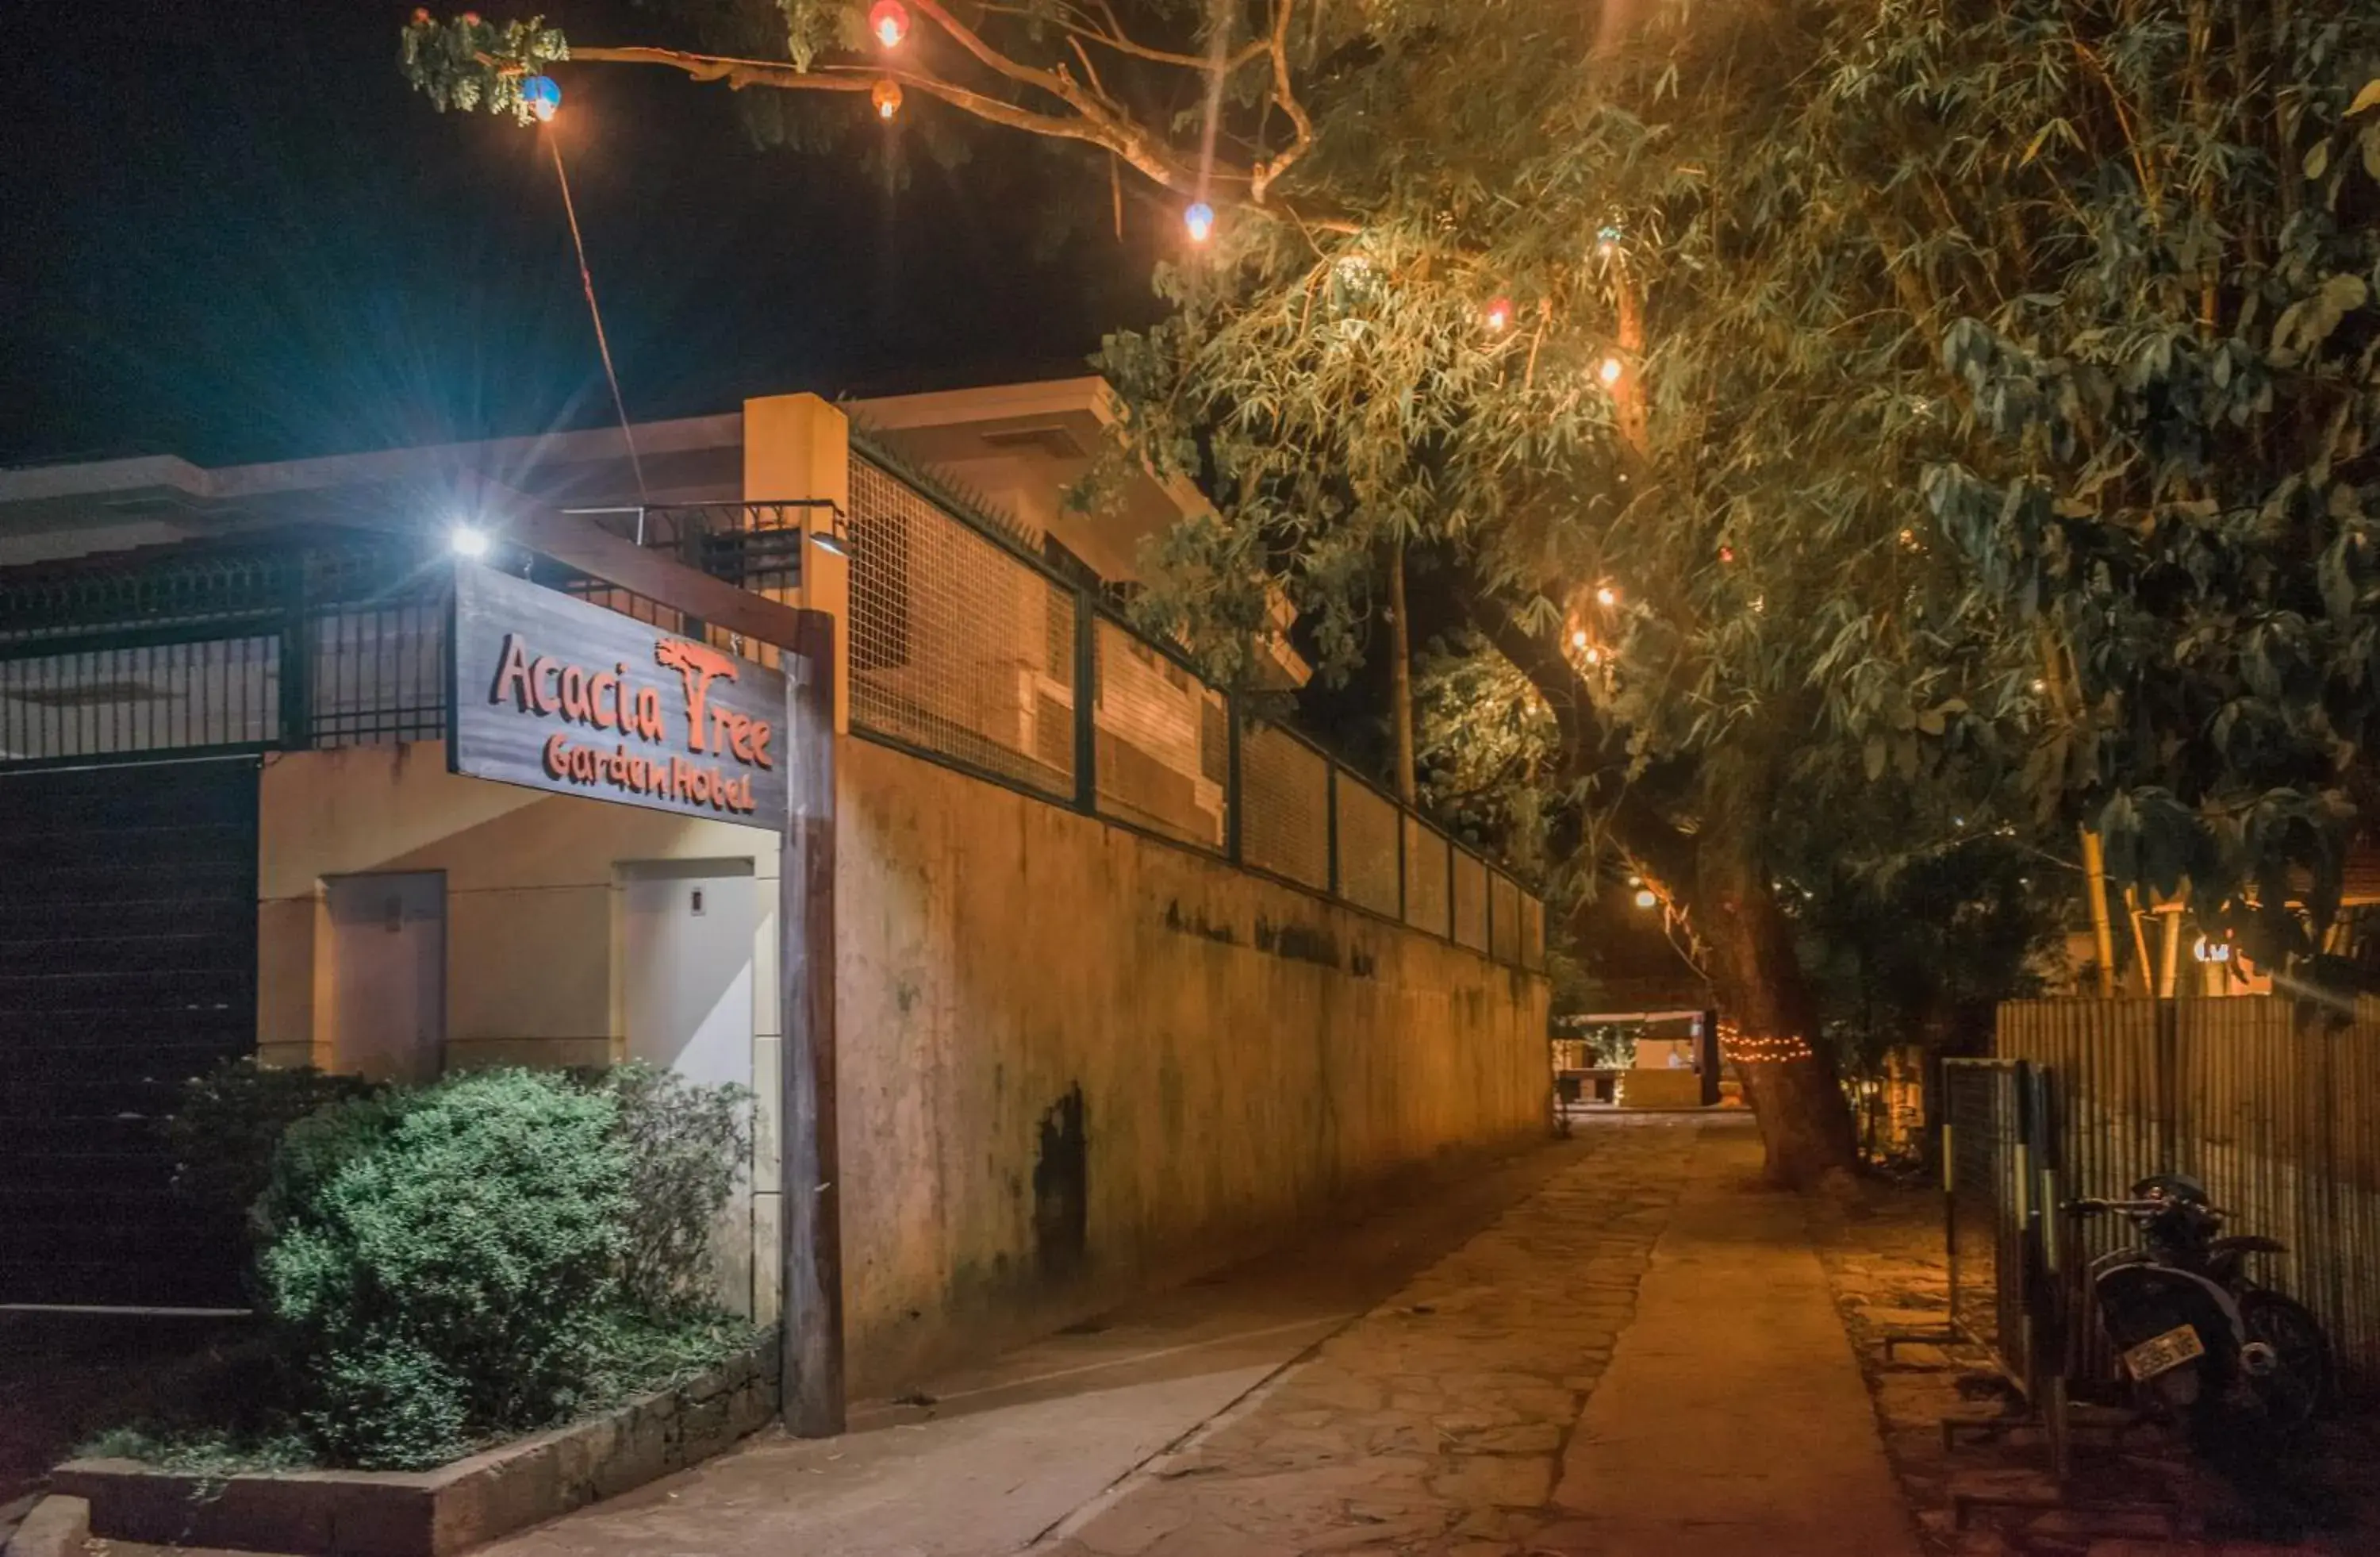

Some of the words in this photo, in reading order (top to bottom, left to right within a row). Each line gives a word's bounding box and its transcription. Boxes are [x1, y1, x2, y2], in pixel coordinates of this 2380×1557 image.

[489, 632, 663, 744] Acacia
[654, 637, 774, 771] Tree
[543, 733, 670, 799] Garden
